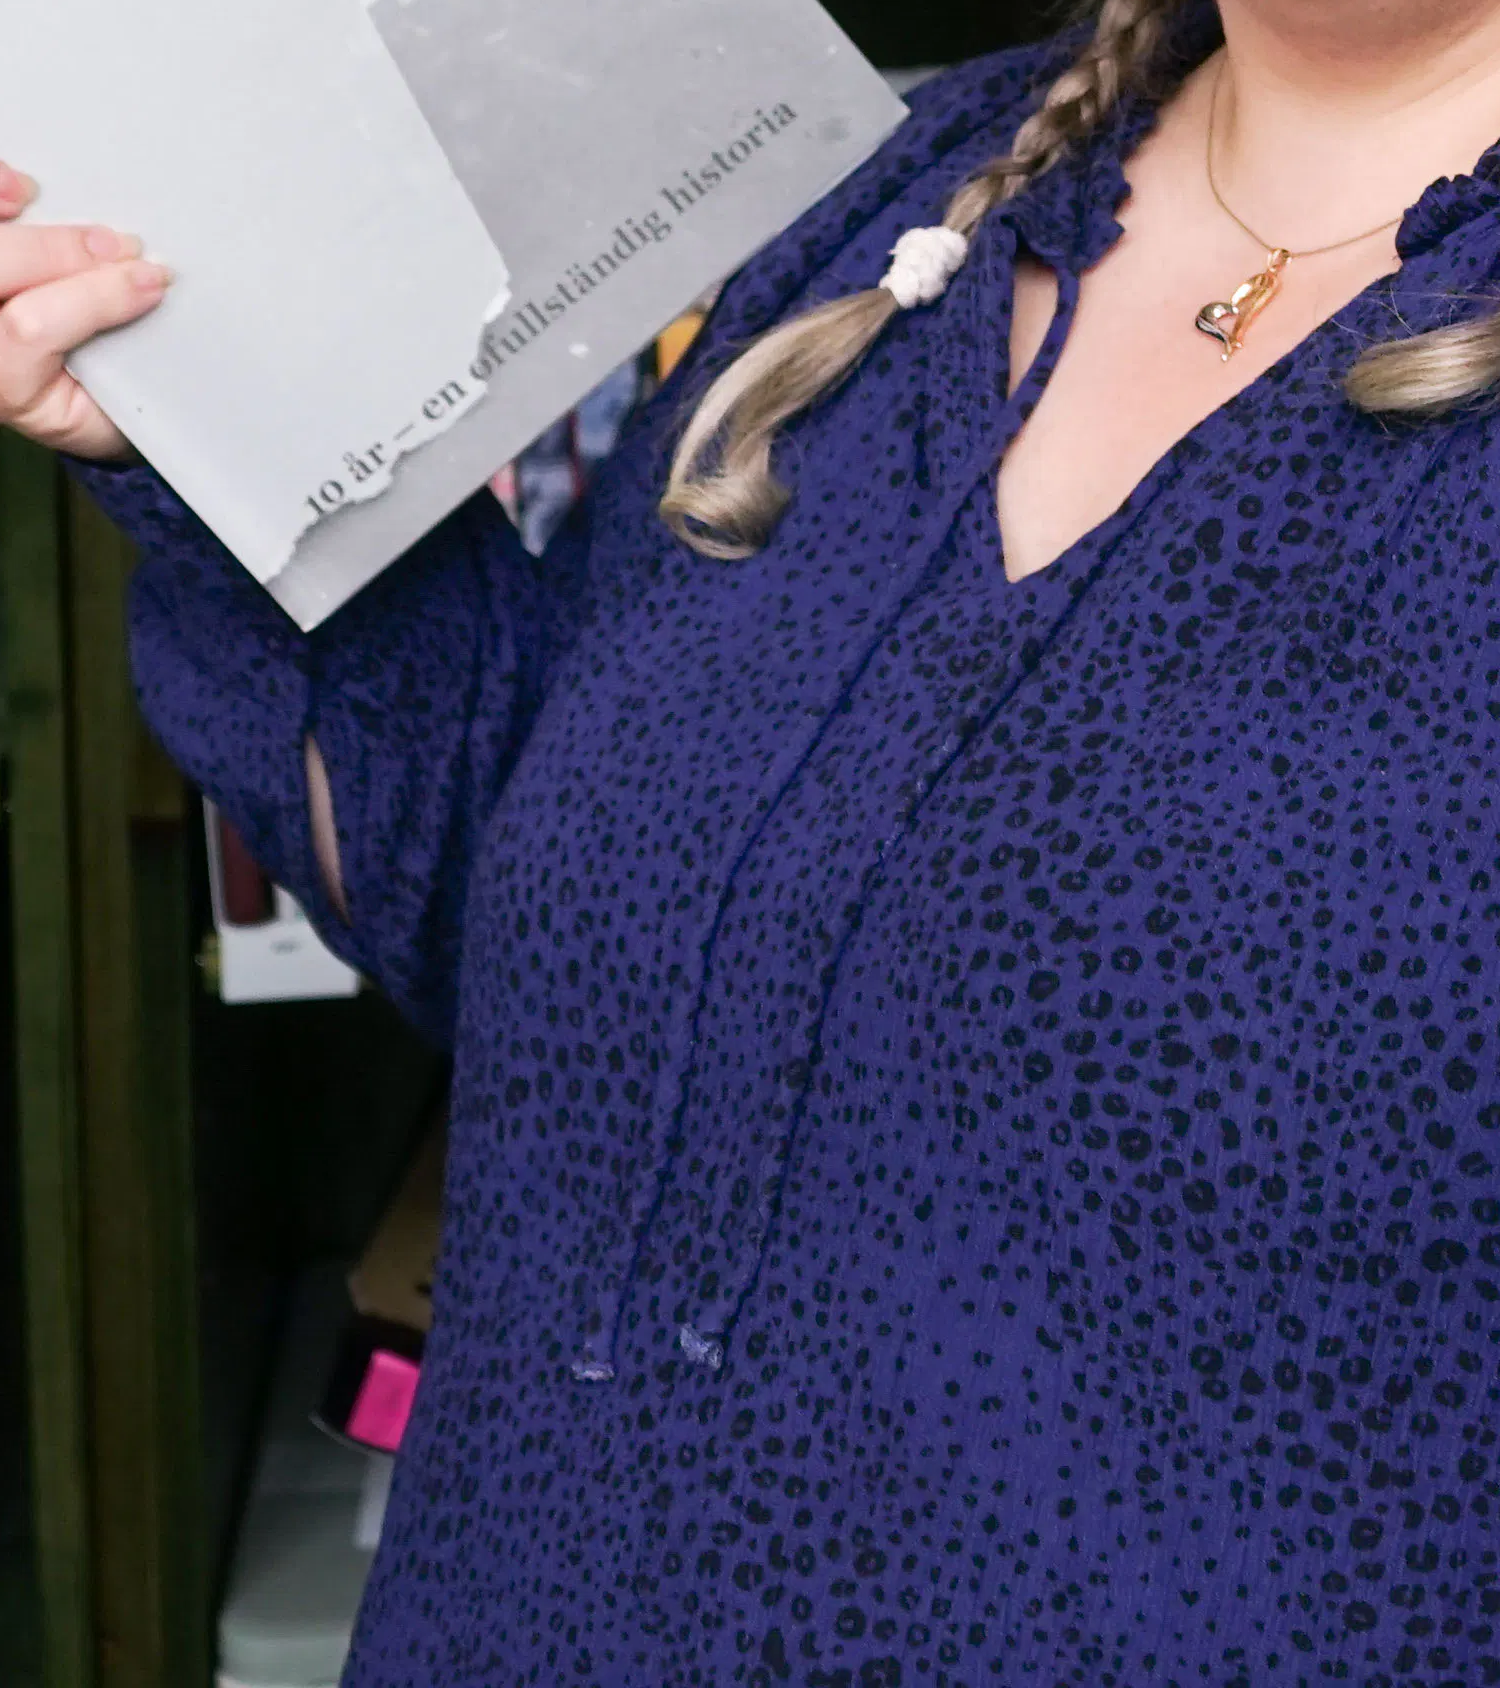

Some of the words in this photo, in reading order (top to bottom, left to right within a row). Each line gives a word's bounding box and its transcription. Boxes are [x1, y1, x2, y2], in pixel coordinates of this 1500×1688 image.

[302, 480, 346, 515] 10
[341, 436, 386, 486] år
[420, 378, 469, 425] en
[468, 209, 674, 384] ofullständig
[661, 98, 798, 213] historia
